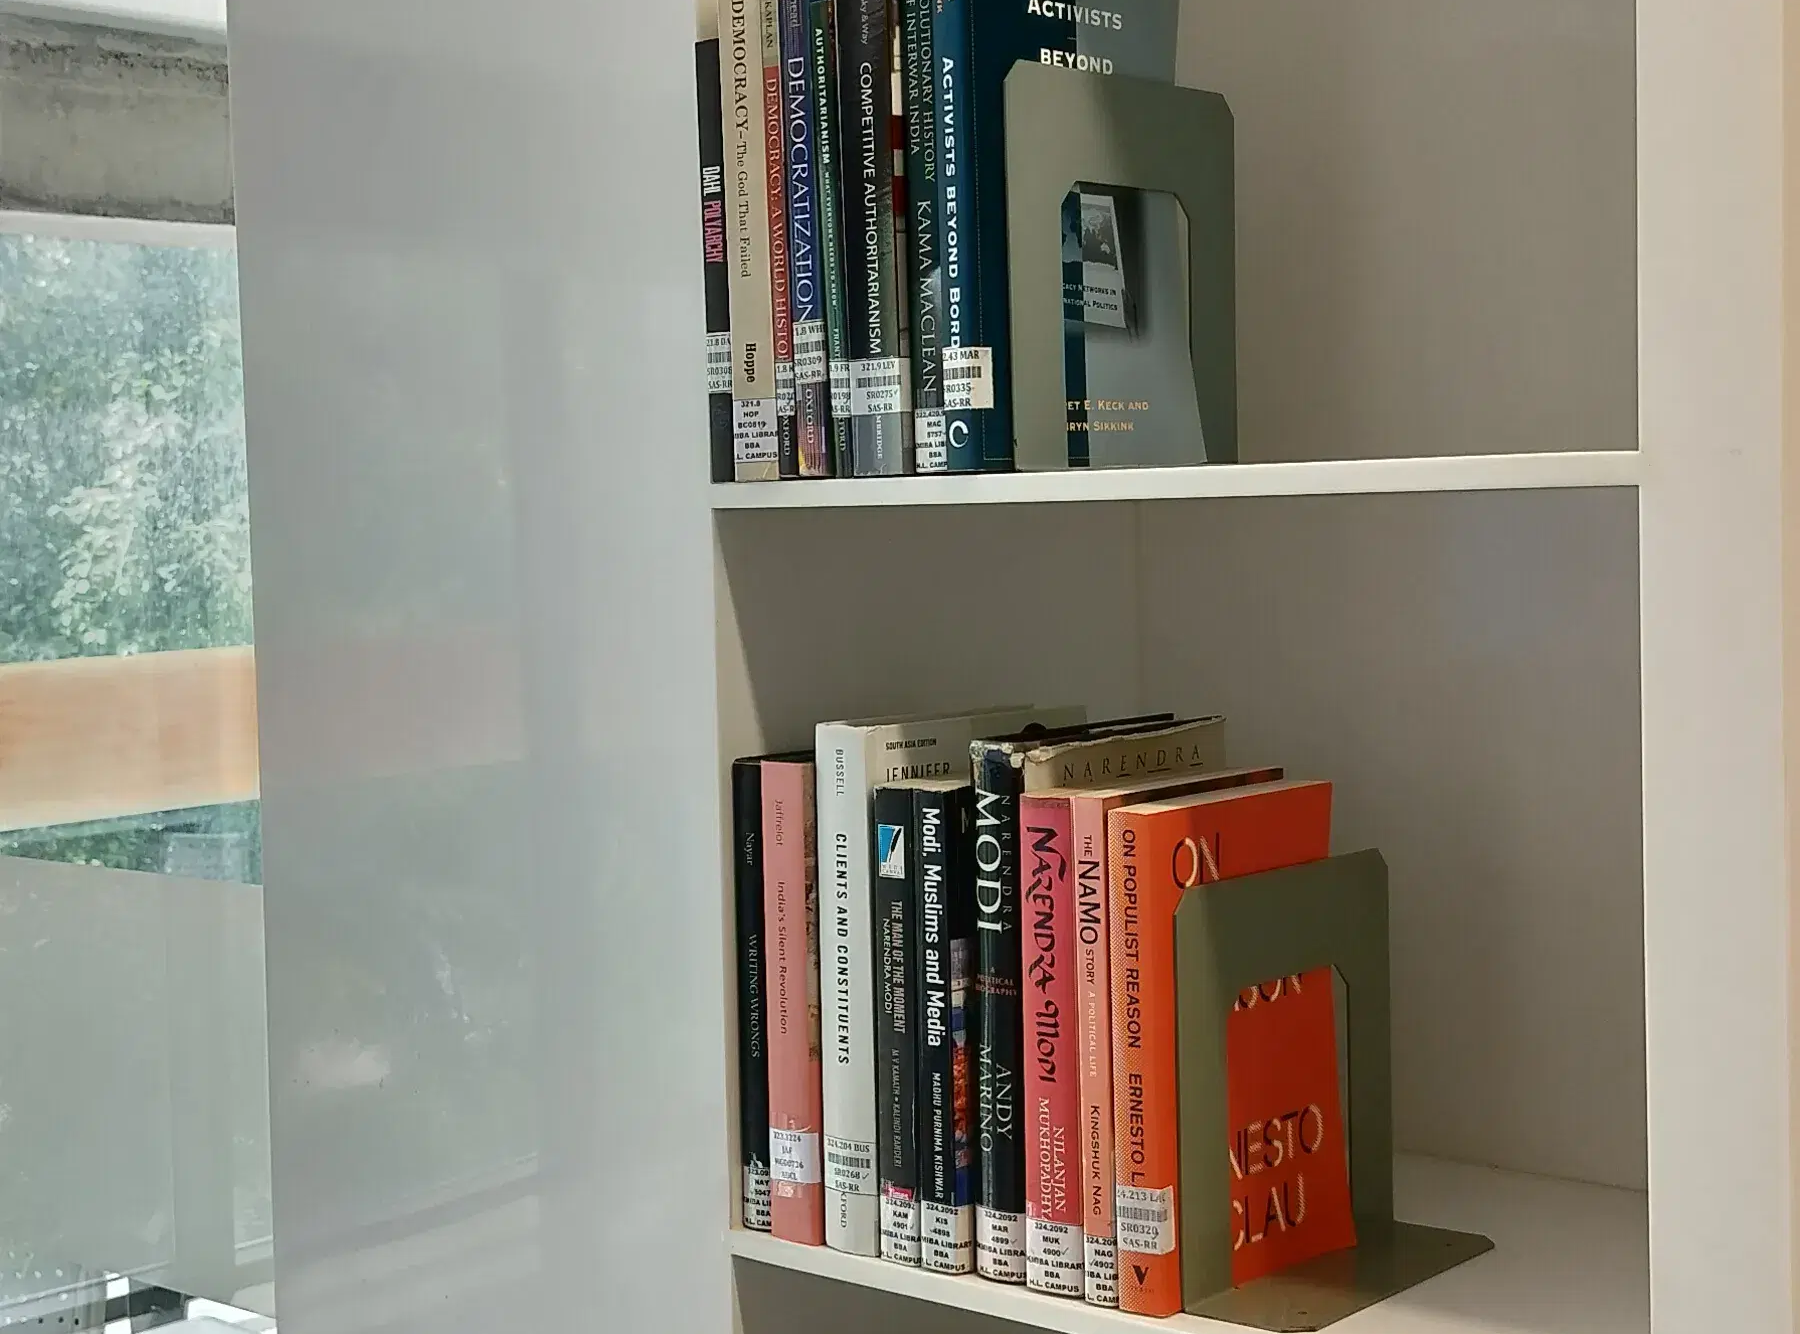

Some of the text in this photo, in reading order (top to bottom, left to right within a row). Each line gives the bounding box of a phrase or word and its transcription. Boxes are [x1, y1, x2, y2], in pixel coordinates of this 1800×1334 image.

[764, 0, 775, 48] KAPLAN
[906, 13, 918, 101] INTERWAR
[1040, 47, 1114, 77] BEYOND
[815, 27, 831, 164] AUTHORITARIANISM
[908, 106, 920, 156] INDIA
[788, 55, 813, 324] DEMOCRATIZATION
[922, 111, 936, 183] HISTORY
[943, 56, 959, 279] ACTIVISTS BEYOND
[702, 166, 724, 263] DAHL POLYARCHY
[859, 62, 882, 354] COMPETITIVE AUTHORITARIANISM
[917, 199, 938, 393] KAMA MACLEAN
[744, 342, 757, 383] Hoppe
[835, 748, 845, 797] BUSSELL
[742, 831, 755, 866] Nayar
[774, 798, 785, 847] Jaffrelot
[975, 786, 1003, 935] MODI
[1001, 794, 1012, 932] NARENDRA
[777, 881, 789, 1035] India's Silent Revolution
[836, 833, 850, 1065] CLIENTS AND CONSTITUENTS
[883, 918, 893, 1014] NARENDRA MODI
[891, 901, 906, 1033] THE MAN OF THE MOMENT
[921, 806, 945, 1047] Modi, Muslims and Media
[1122, 829, 1142, 1049] ON POPULIST REASON
[748, 933, 761, 1058] WRITING WRONGS
[932, 1071, 945, 1199] MADHU PURNIMA KISHWAR
[979, 1044, 993, 1152] MARINO
[997, 1064, 1012, 1141] ANDY
[1128, 1073, 1145, 1165] ERNESTO
[1053, 1126, 1066, 1213] NILANJAN
[1090, 1105, 1102, 1216] KINGSHUK NAG
[983, 1210, 1018, 1222] 324.2092
[1034, 1222, 1069, 1234] 324.2092
[1042, 1235, 1060, 1244] MUK
[1093, 1248, 1114, 1258] NAG
[1044, 1281, 1080, 1293] CAMPUS
